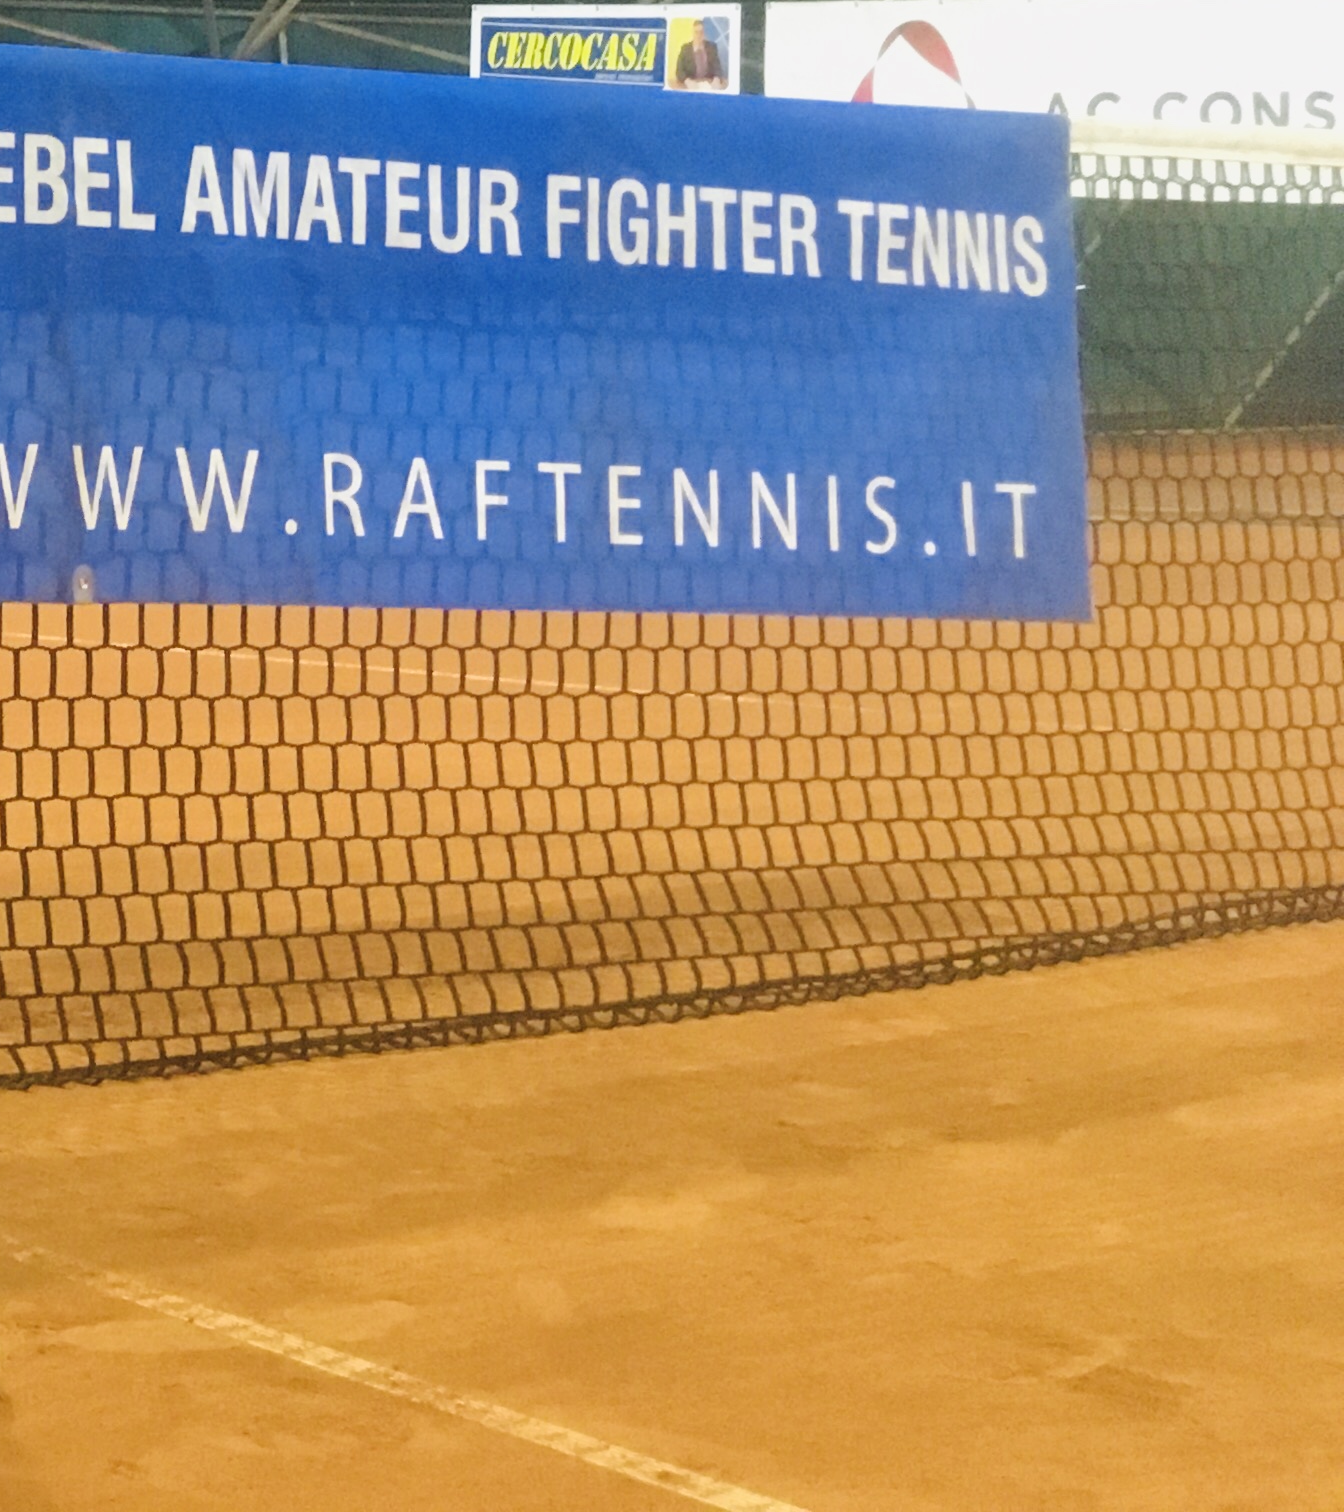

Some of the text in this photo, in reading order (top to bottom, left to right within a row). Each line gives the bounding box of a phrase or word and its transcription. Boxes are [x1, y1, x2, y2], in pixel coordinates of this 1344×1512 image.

[487, 31, 658, 72] CERCOCASA
[180, 145, 523, 257] AMATEUR
[546, 174, 822, 279] FIGHTER
[837, 199, 1048, 298] TENNIS
